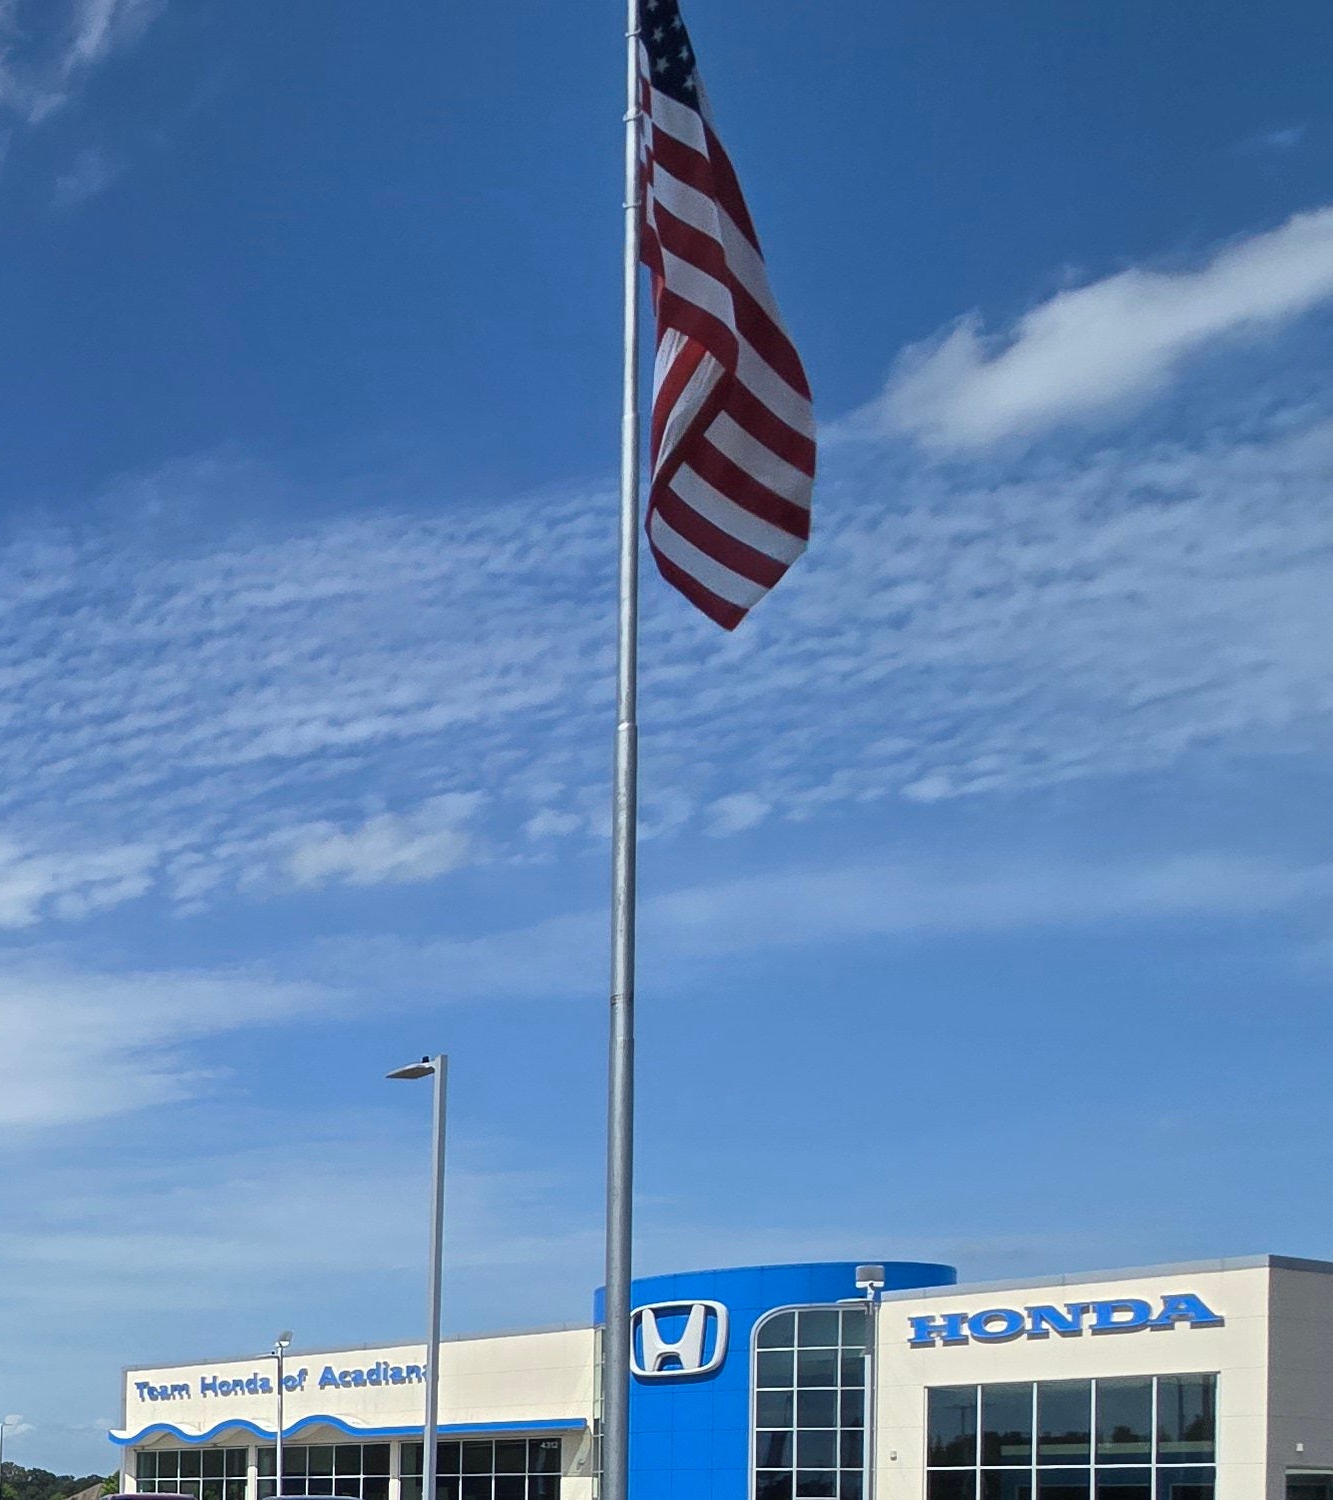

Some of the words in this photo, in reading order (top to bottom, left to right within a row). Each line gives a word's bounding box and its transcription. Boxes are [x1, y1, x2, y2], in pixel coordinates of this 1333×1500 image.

[907, 1293, 1225, 1349] HONDA
[135, 1381, 191, 1402] Team
[200, 1372, 274, 1398] Honda
[282, 1368, 309, 1392] of
